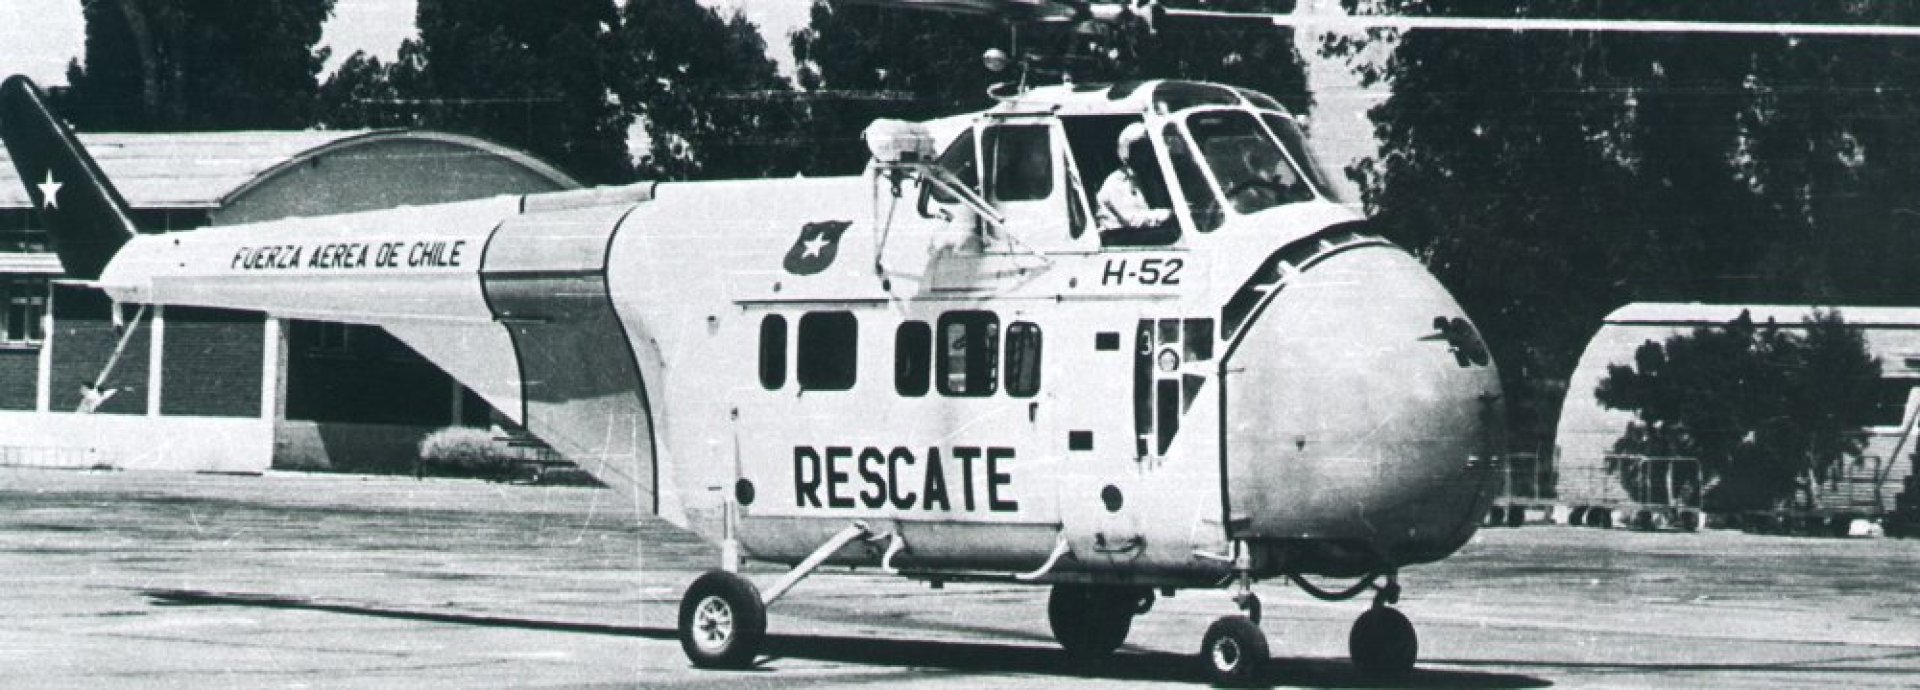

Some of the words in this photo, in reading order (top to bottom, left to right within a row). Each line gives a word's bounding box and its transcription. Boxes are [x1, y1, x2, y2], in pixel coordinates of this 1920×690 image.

[231, 244, 303, 269] FUERZA
[308, 242, 369, 268] AEREA
[375, 241, 404, 268] DE
[408, 240, 466, 267] CHILE
[1101, 258, 1184, 286] H-52
[793, 445, 1019, 512] RESCATE
